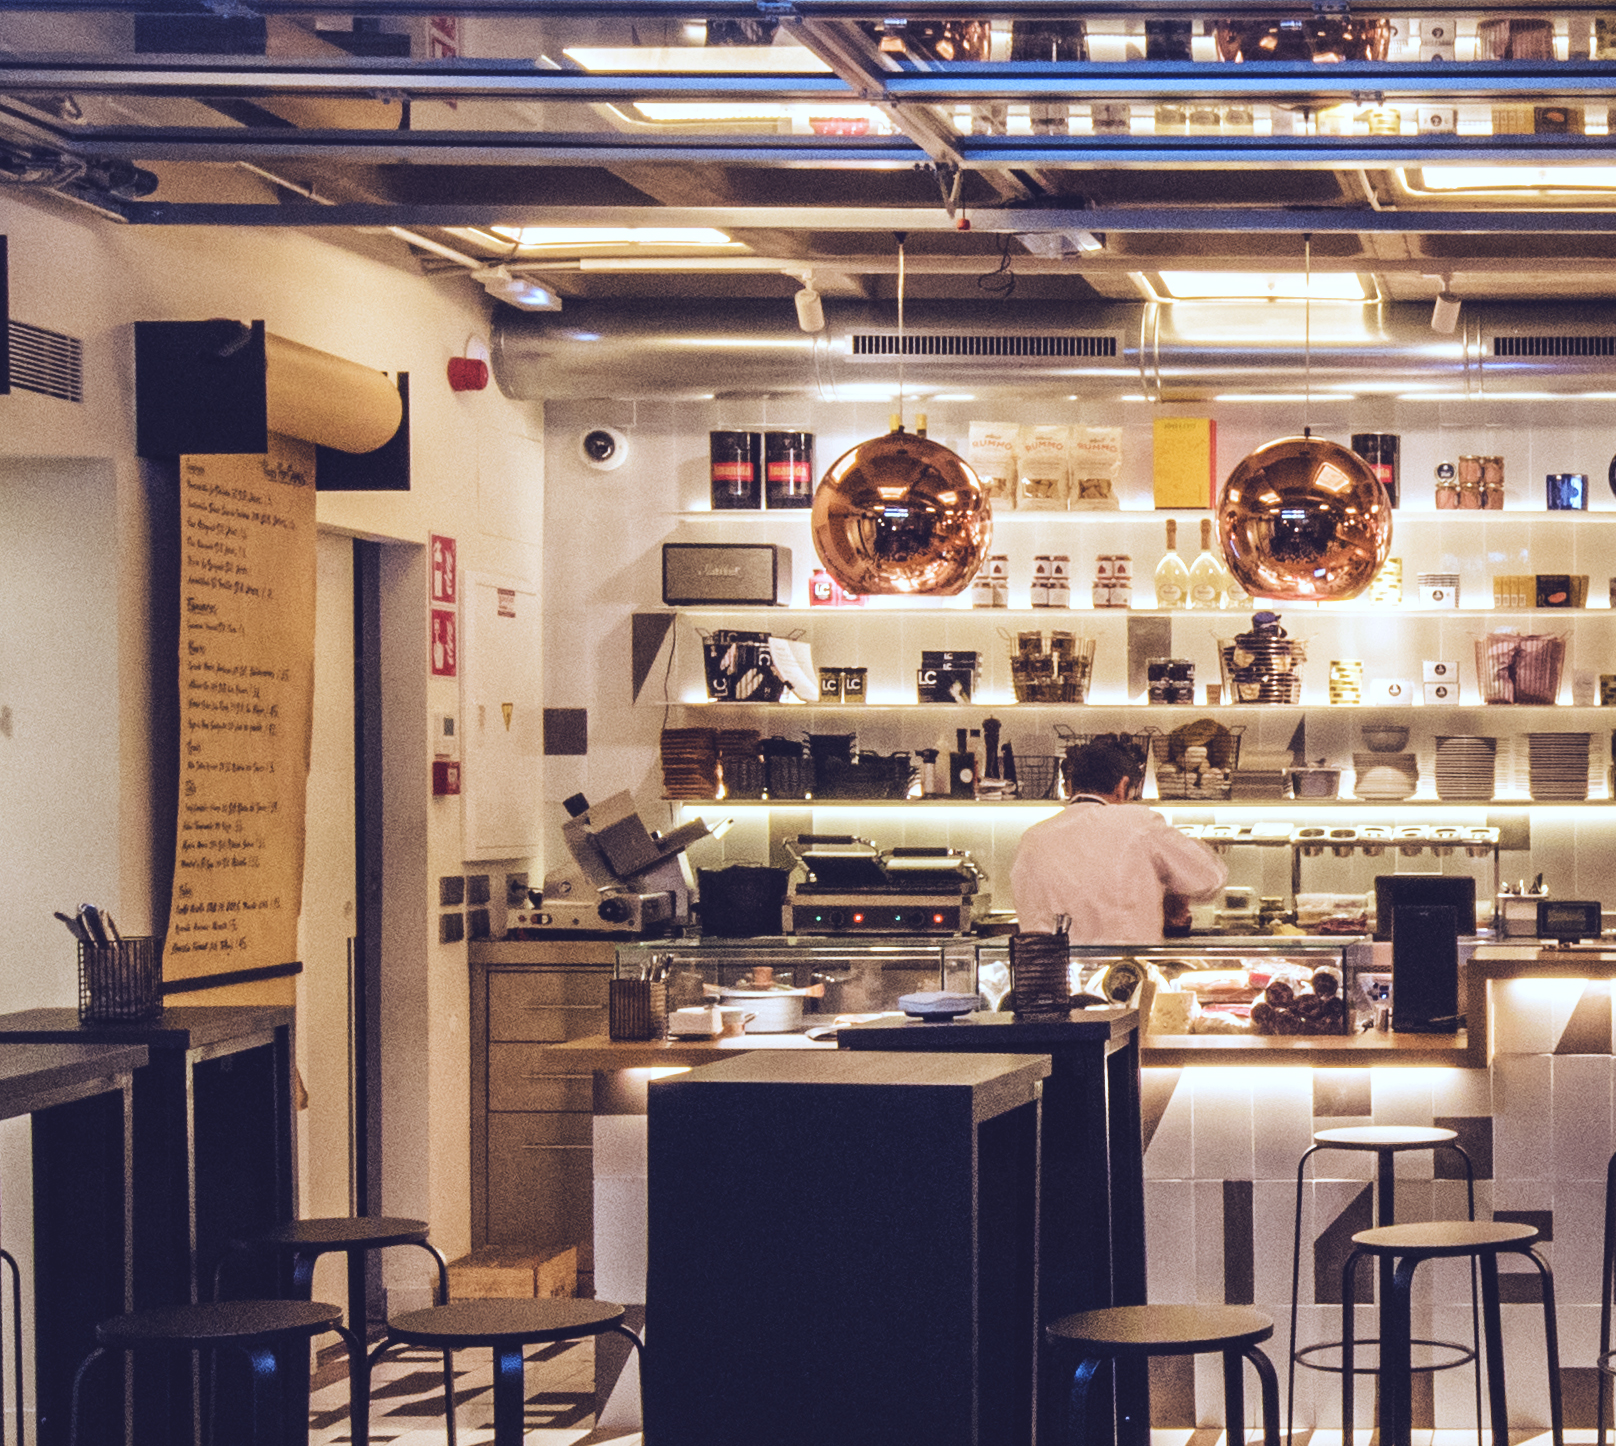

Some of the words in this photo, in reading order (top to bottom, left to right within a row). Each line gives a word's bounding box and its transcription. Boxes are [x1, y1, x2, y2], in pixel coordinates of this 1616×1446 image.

[972, 439, 1013, 451] RUMMO
[1025, 440, 1064, 452] RUMMO
[1077, 442, 1118, 453] RUMMO
[815, 583, 830, 596] LC
[918, 671, 937, 685] LC
[822, 680, 837, 691] LC
[846, 679, 861, 690] LC
